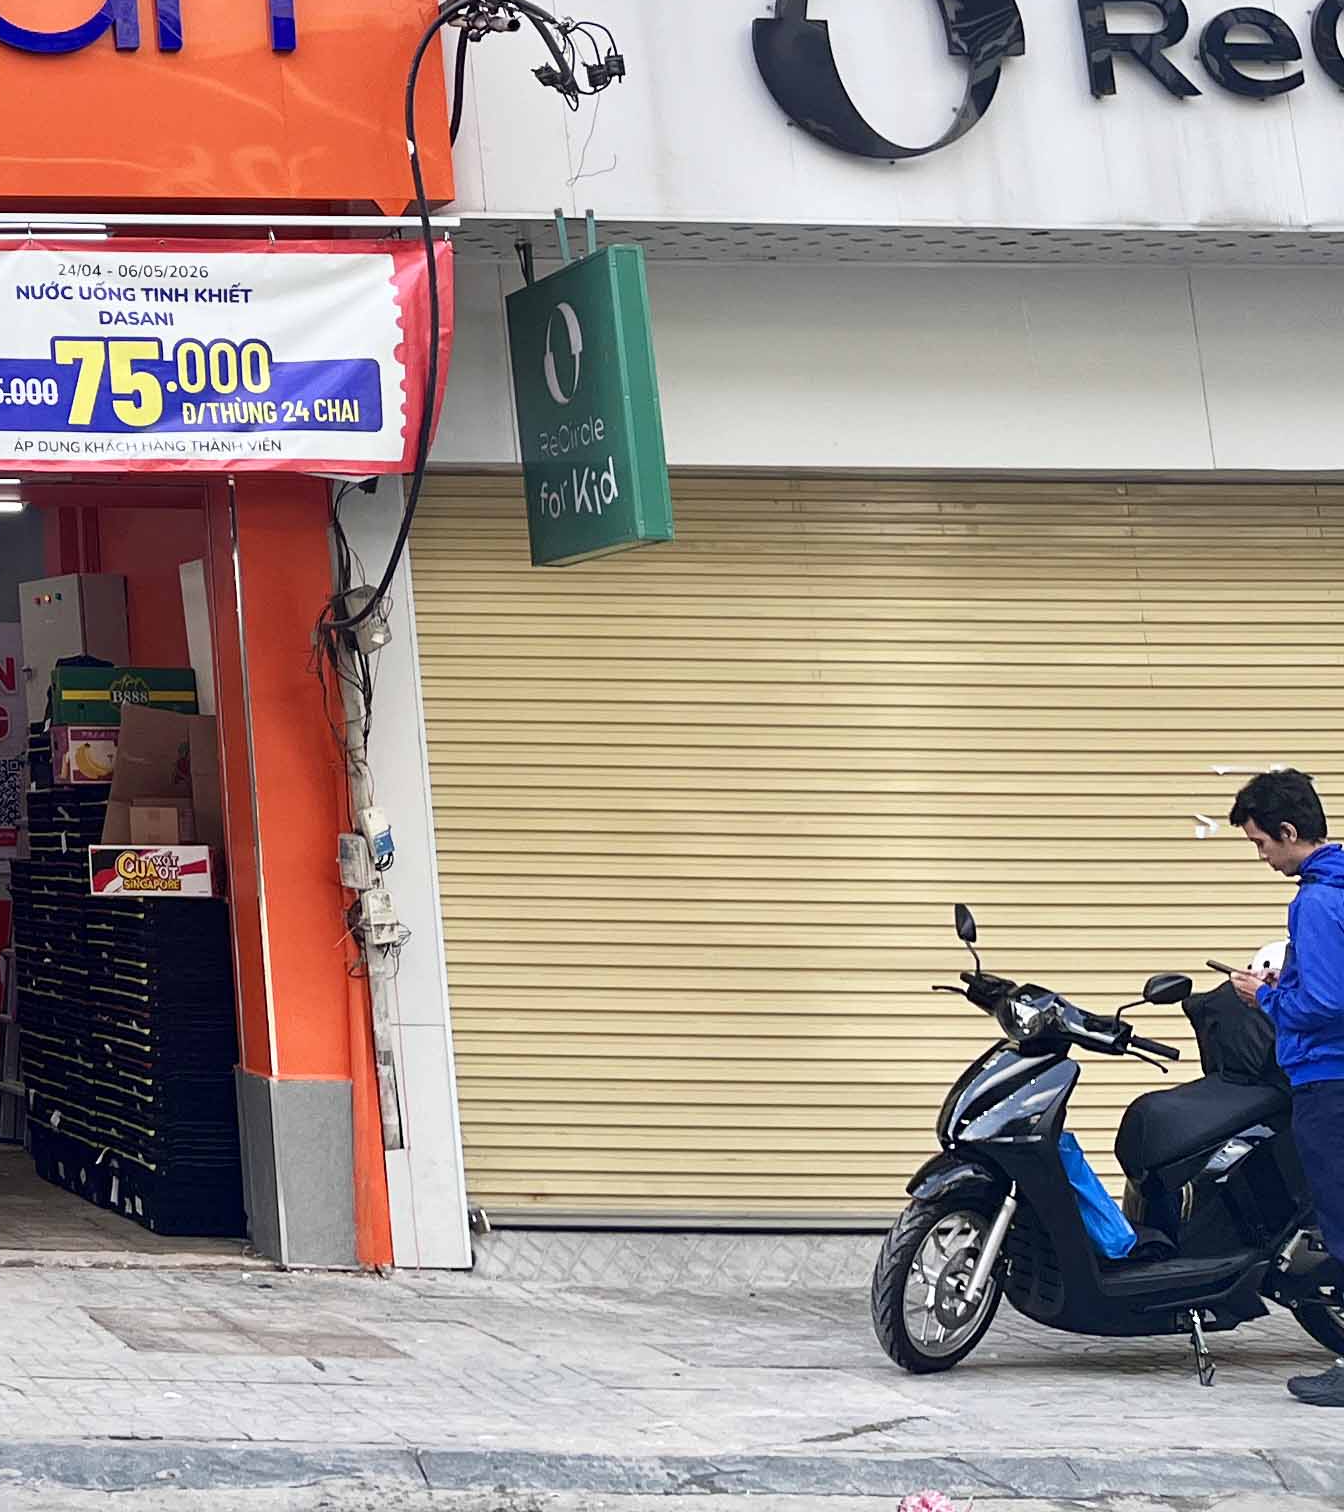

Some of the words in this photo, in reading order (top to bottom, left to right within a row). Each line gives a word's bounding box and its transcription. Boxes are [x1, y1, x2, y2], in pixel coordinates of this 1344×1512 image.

[58, 264, 102, 278] 24/04
[118, 264, 209, 279] 06/05/2026
[15, 282, 73, 301] NƯỚC
[78, 281, 136, 303] UỐNG
[140, 286, 192, 303] TINH
[194, 281, 254, 304] KHIẾT
[98, 310, 175, 326] DASANI
[54, 339, 272, 428] 75.000
[182, 398, 277, 426] Đ/THÙNG
[281, 400, 310, 423] 24
[313, 399, 360, 424] CHAI
[84, 438, 137, 454] KHÁCH
[539, 415, 606, 457] ReCircle
[539, 479, 568, 519] for
[572, 455, 619, 516] Kid
